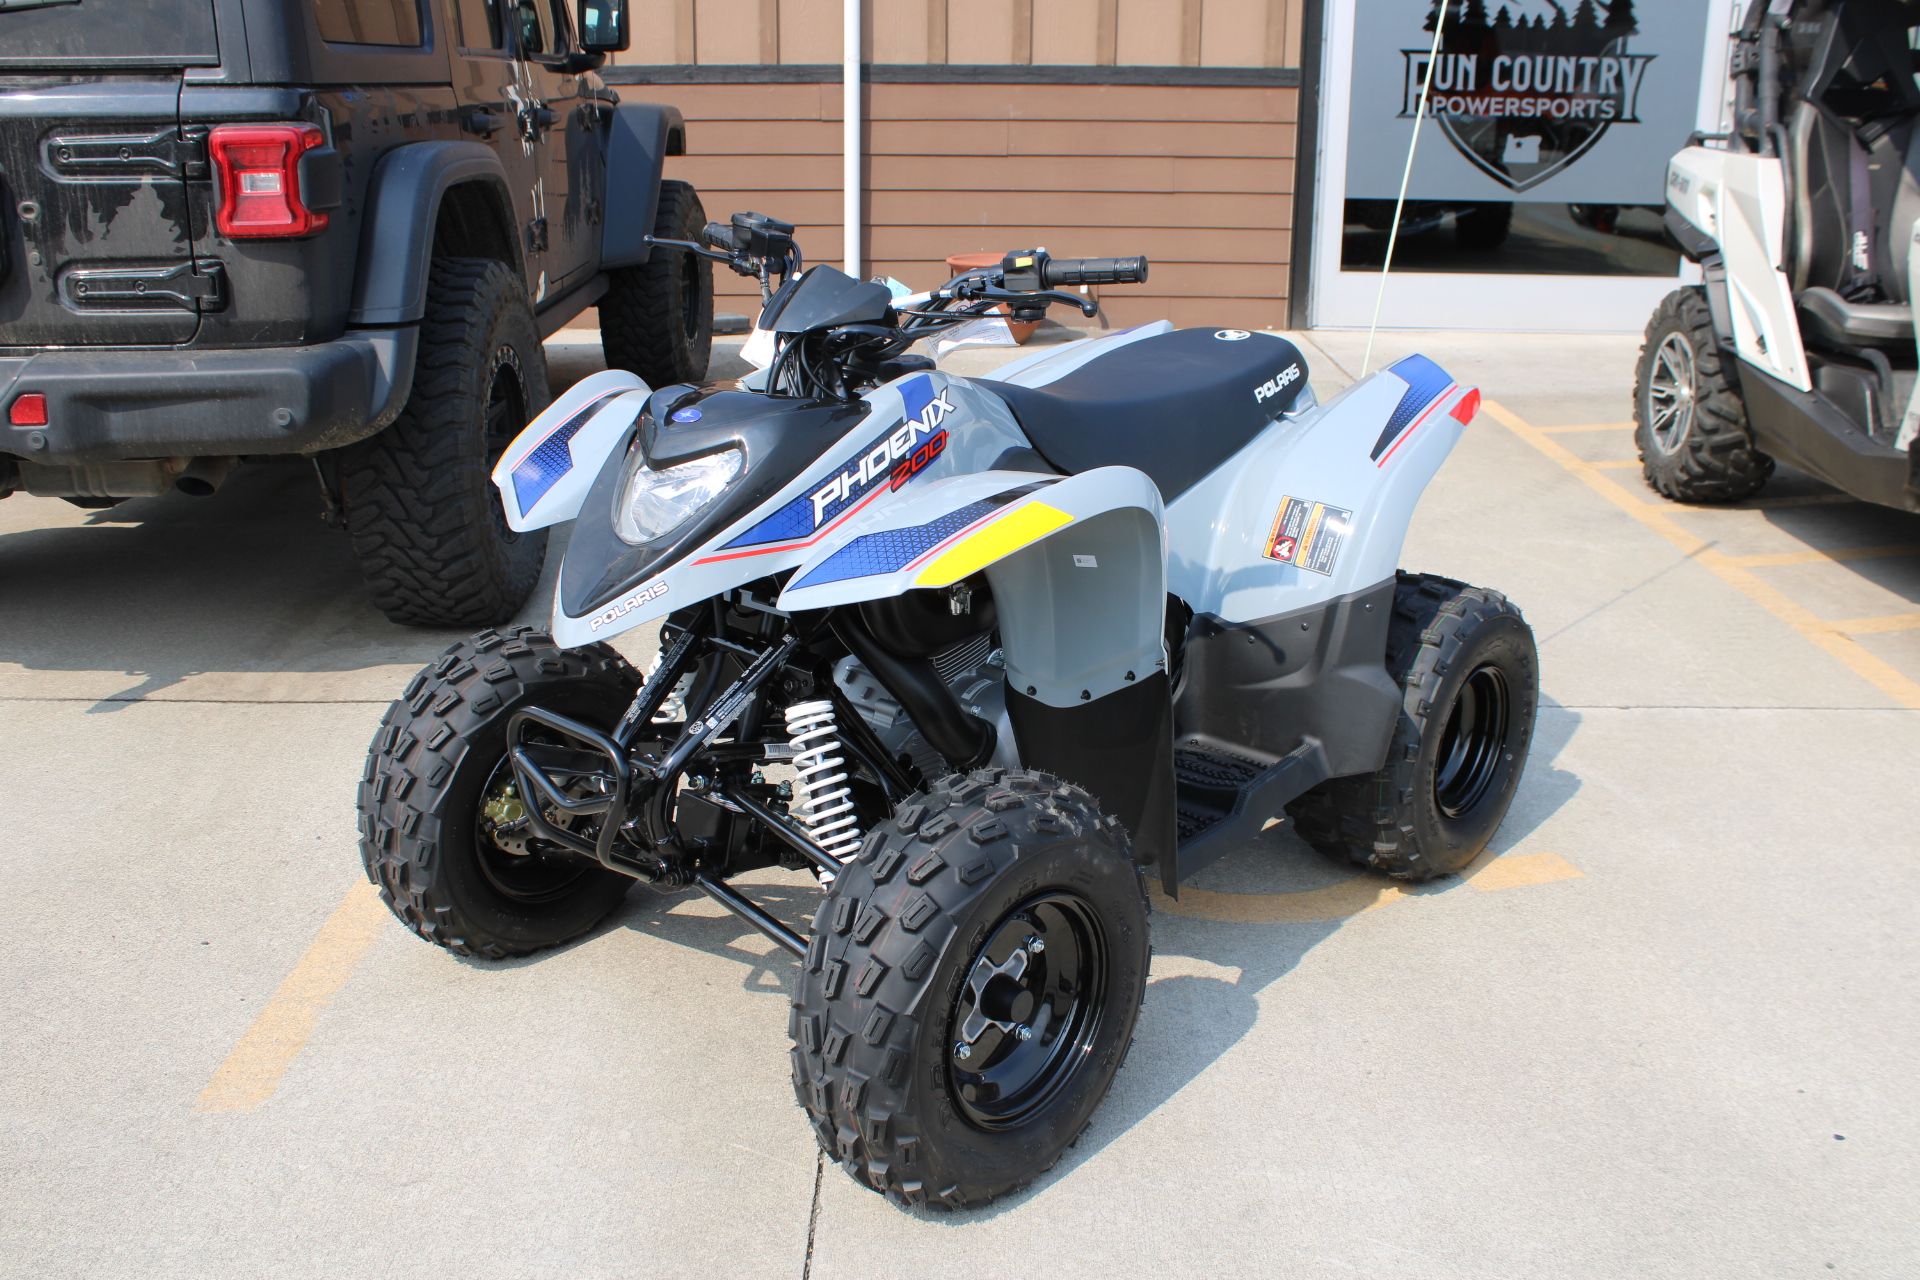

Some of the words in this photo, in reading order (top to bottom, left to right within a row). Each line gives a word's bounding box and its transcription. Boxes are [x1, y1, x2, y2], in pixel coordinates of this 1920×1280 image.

[1402, 52, 1479, 117] FUN
[1491, 54, 1654, 121] COUNTRY
[1432, 96, 1616, 119] POWERSPORTS
[1253, 362, 1301, 404] POLARIS
[809, 386, 957, 528] PHOENIX
[890, 428, 950, 494] 200
[589, 580, 670, 632] POLARIS
